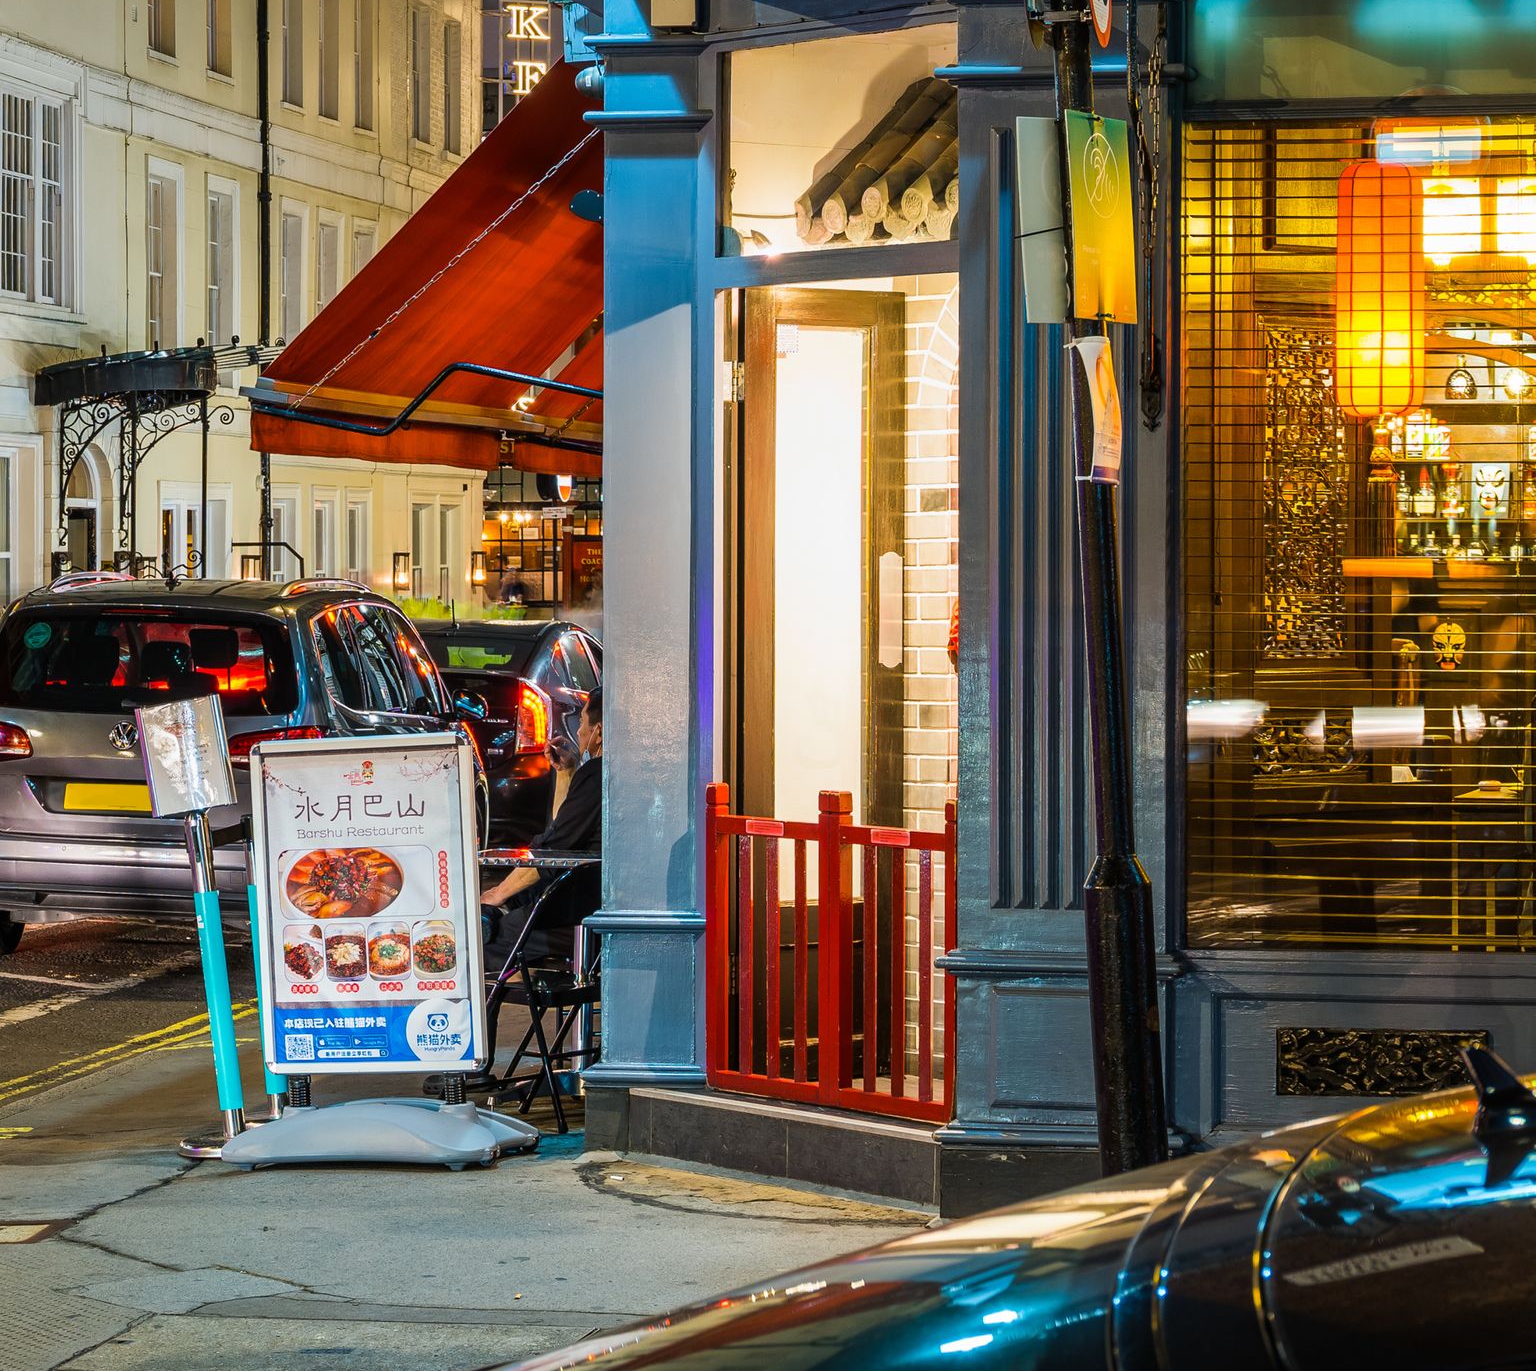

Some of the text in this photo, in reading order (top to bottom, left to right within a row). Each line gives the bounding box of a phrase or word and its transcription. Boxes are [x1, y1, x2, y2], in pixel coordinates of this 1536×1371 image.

[294, 793, 425, 822] 水月巴山
[297, 824, 425, 839] Barshu Restaurant
[284, 1016, 387, 1029] 本店现已入驻熊猫外卖
[416, 1033, 462, 1046] 熊猫外卖
